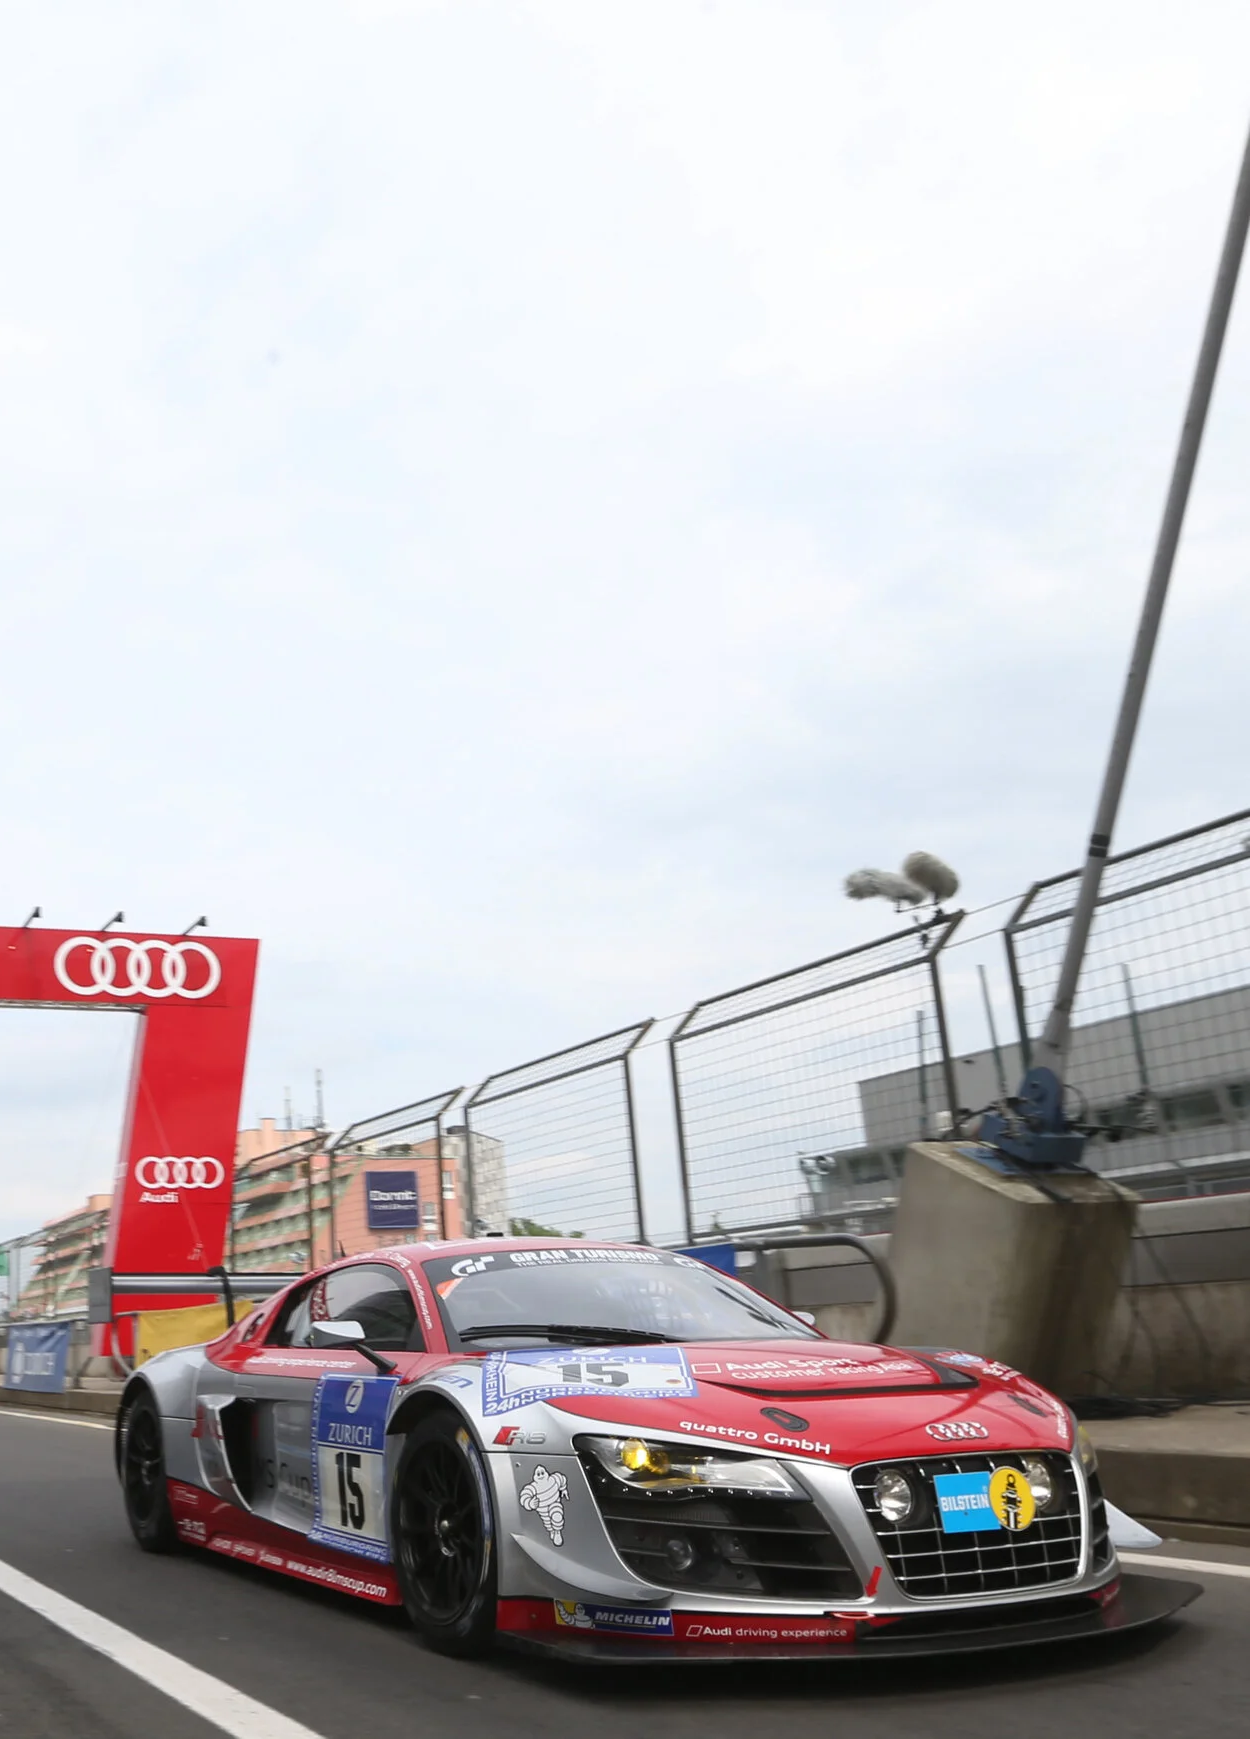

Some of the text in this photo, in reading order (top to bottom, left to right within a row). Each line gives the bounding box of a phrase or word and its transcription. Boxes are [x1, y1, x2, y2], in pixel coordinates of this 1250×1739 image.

[139, 1192, 179, 1203] Audi
[510, 1249, 658, 1263] GRAN TURISMO
[725, 1358, 858, 1371] Audi Sport
[731, 1367, 824, 1379] customer
[828, 1364, 882, 1376] racing
[558, 1362, 630, 1387] 15
[485, 1397, 523, 1414] 24h
[328, 1423, 373, 1446] ZURICH
[679, 1421, 830, 1455] quattro GmbH
[335, 1452, 366, 1530] 15
[940, 1493, 990, 1511] BILSTEIN
[595, 1610, 671, 1626] MICHELIN
[703, 1626, 848, 1638] Audi driving experience
